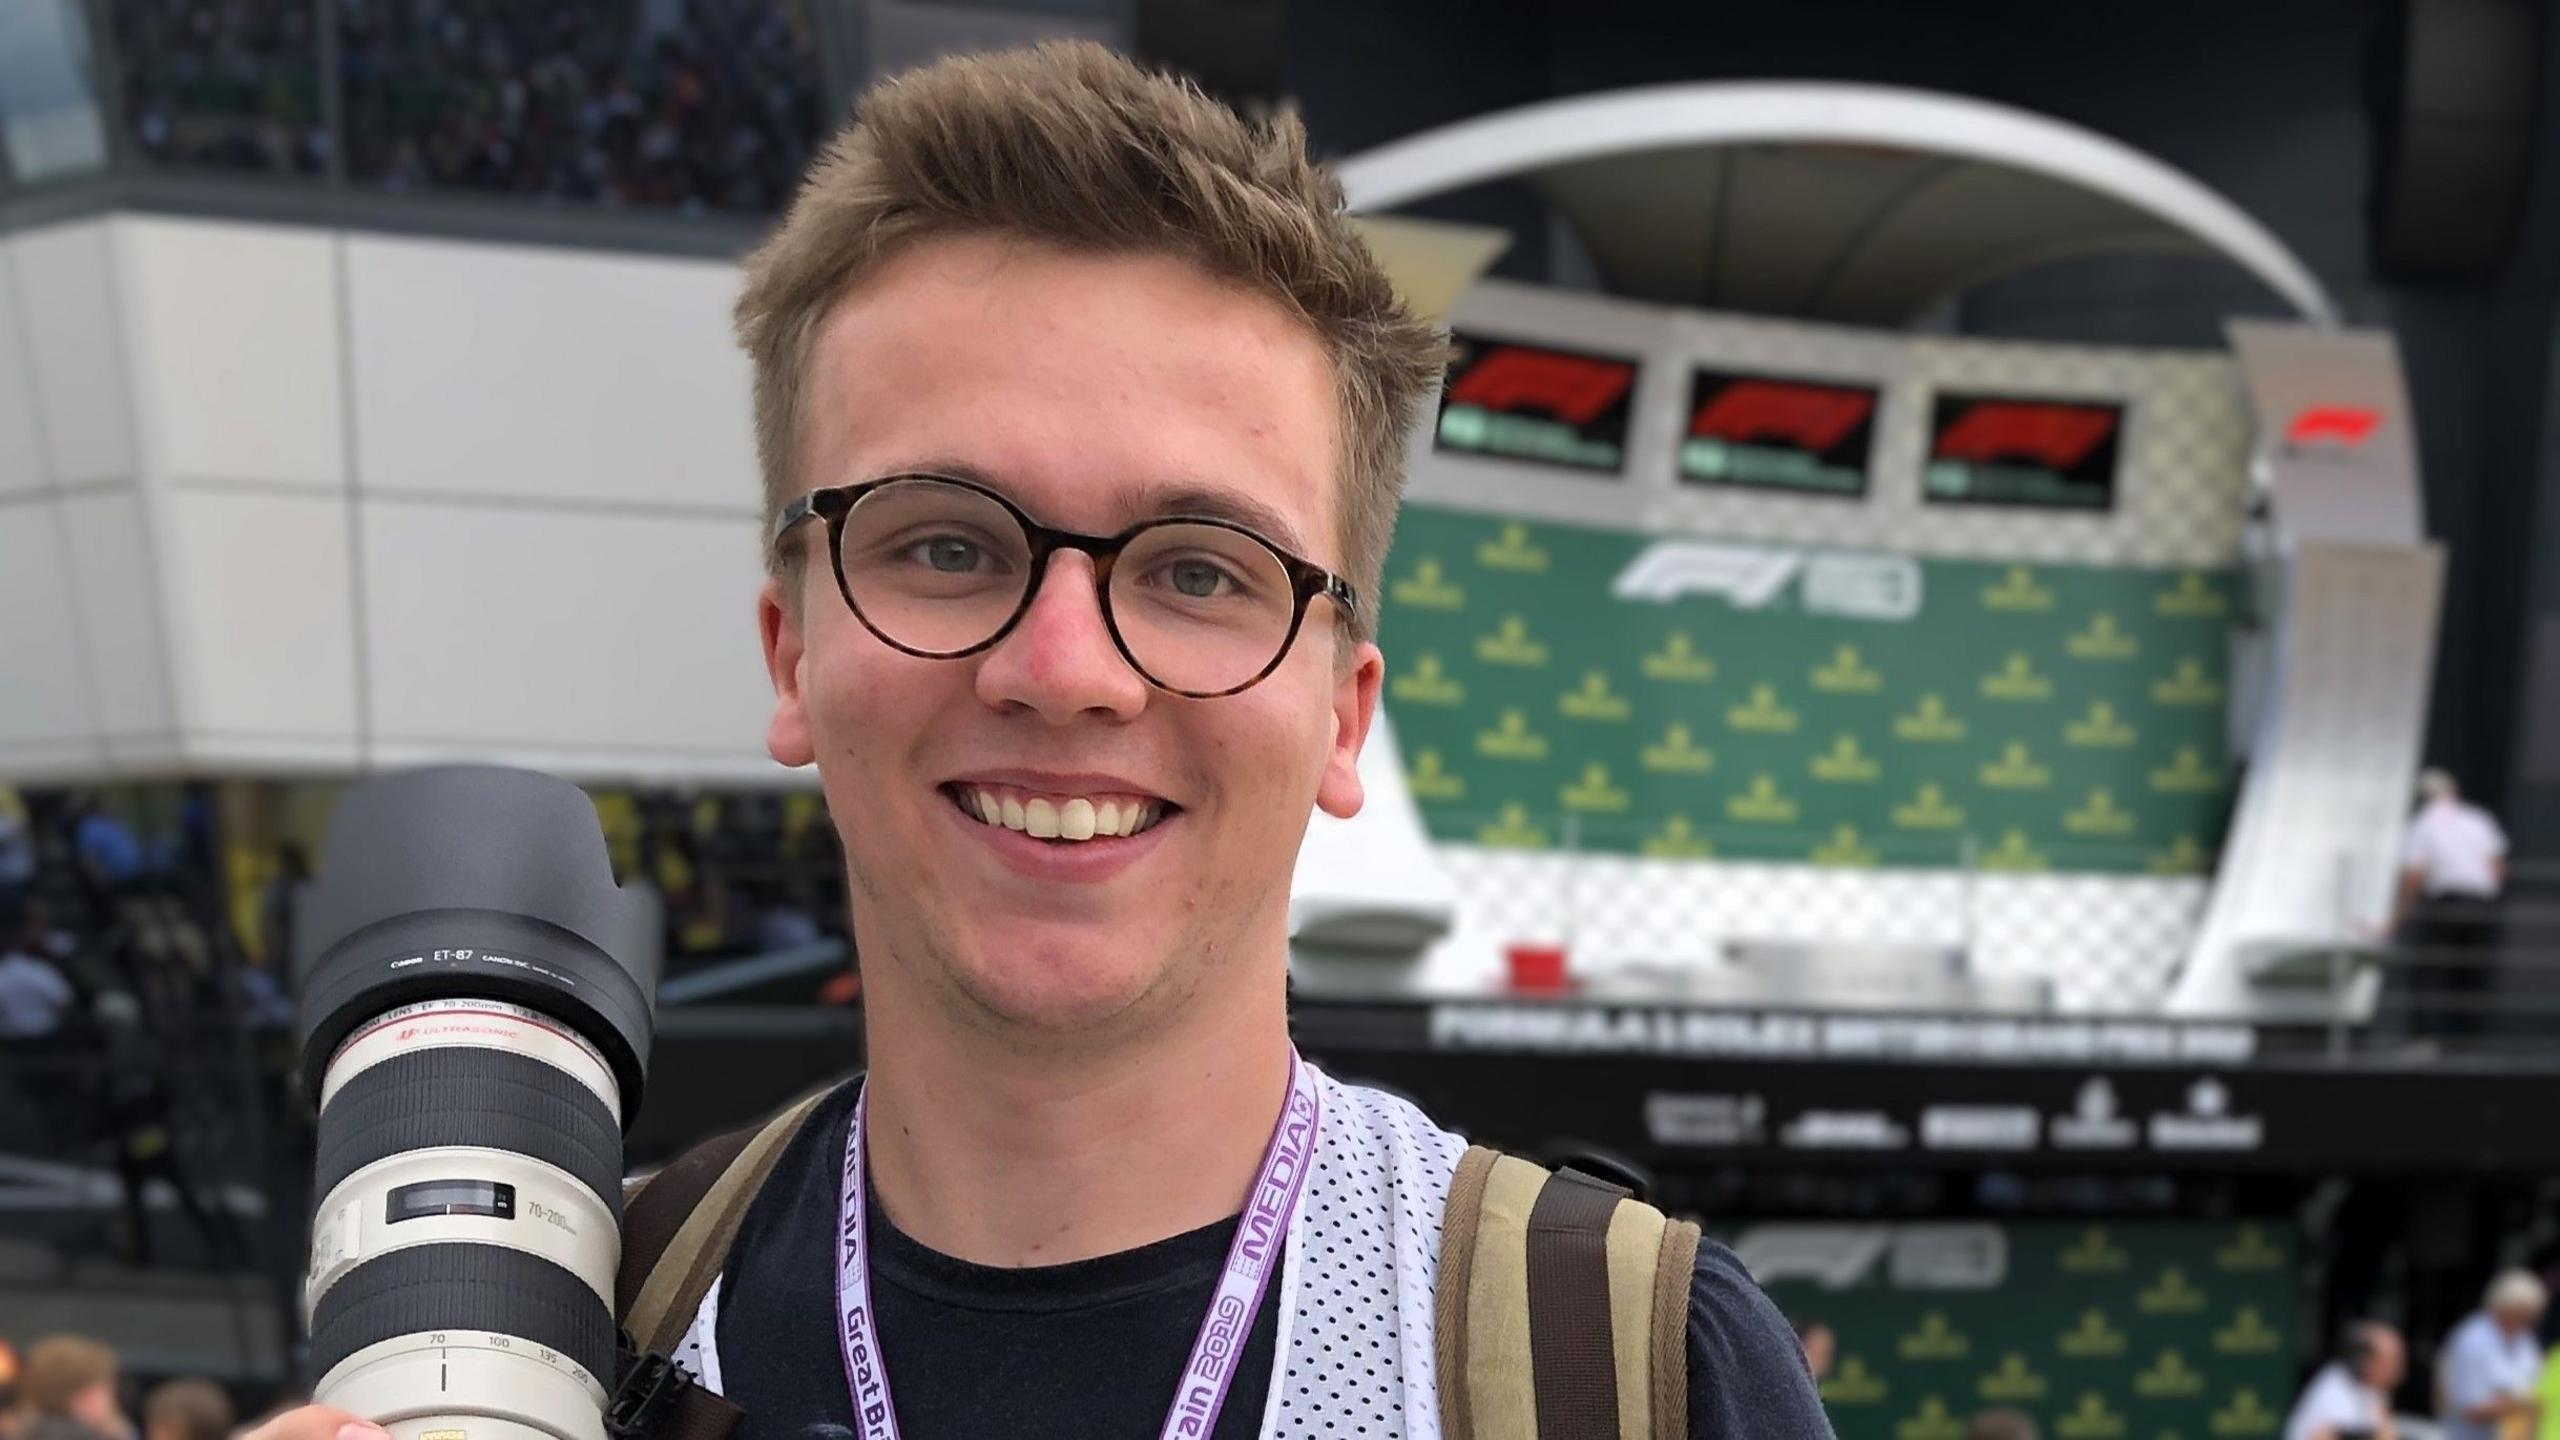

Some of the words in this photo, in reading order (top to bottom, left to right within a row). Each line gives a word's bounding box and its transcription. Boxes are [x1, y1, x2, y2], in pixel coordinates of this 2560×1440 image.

[433, 950, 474, 961] ET-87
[1242, 1122, 1308, 1262] MEDIA
[429, 1333, 446, 1344] 70
[488, 1335, 510, 1348] 100
[539, 1348, 558, 1364] 135
[571, 1365, 589, 1384] 200
[847, 1305, 880, 1402] Great
[864, 1399, 891, 1440] Br
[1193, 1295, 1245, 1382] 2019
[1174, 1386, 1213, 1440] ain
